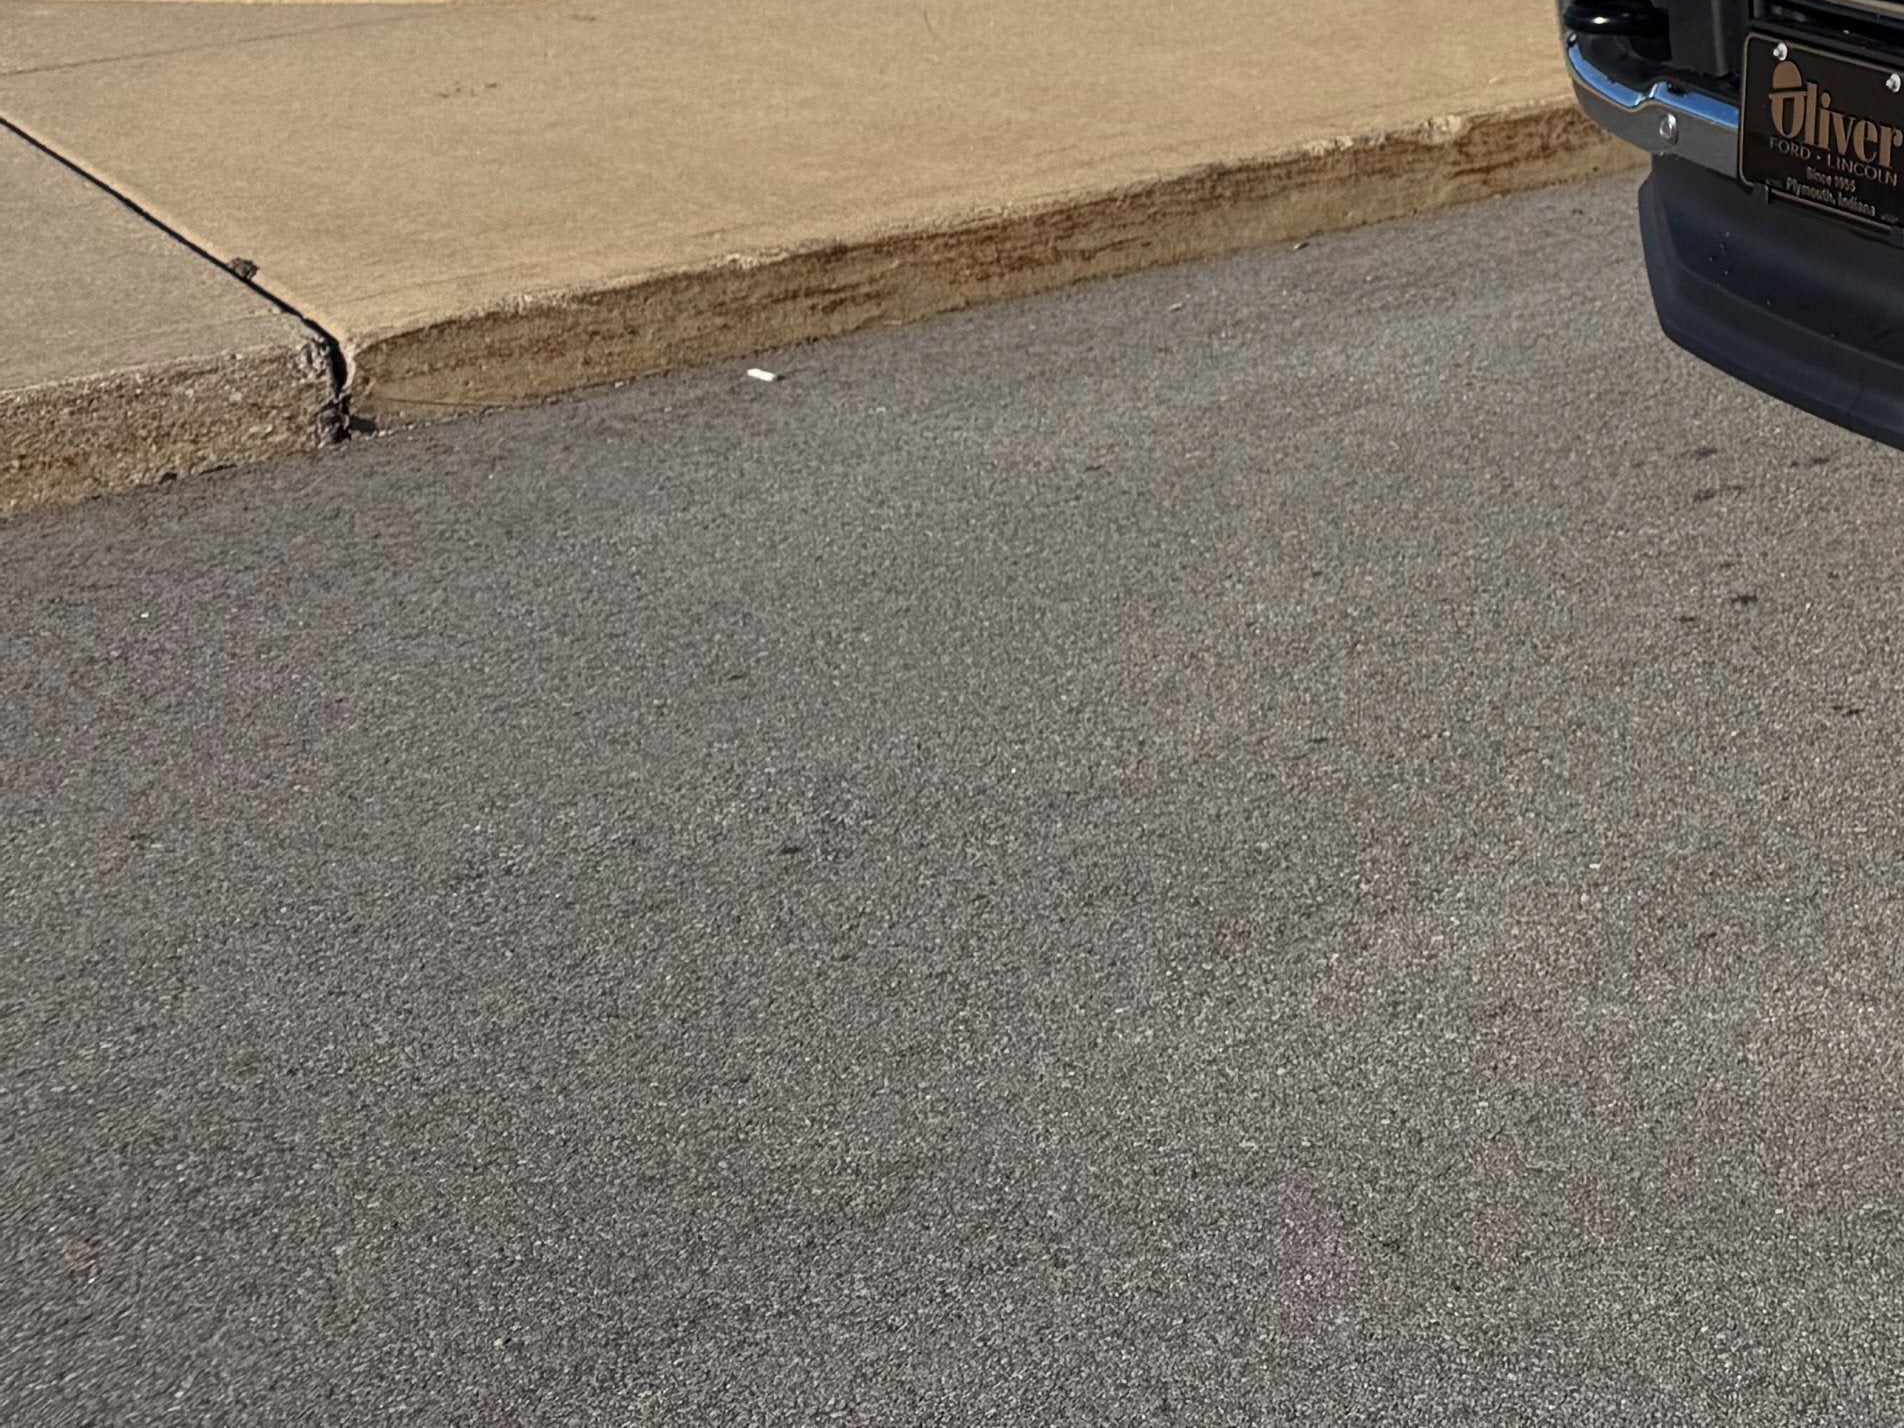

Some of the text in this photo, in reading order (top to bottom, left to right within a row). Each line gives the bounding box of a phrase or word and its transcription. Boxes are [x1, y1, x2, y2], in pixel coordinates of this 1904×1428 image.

[1769, 60, 1904, 168] Oliver
[1770, 137, 1899, 187] FORD LINCOLN
[1806, 166, 1832, 187] Since
[1838, 191, 1876, 217] Indiana
